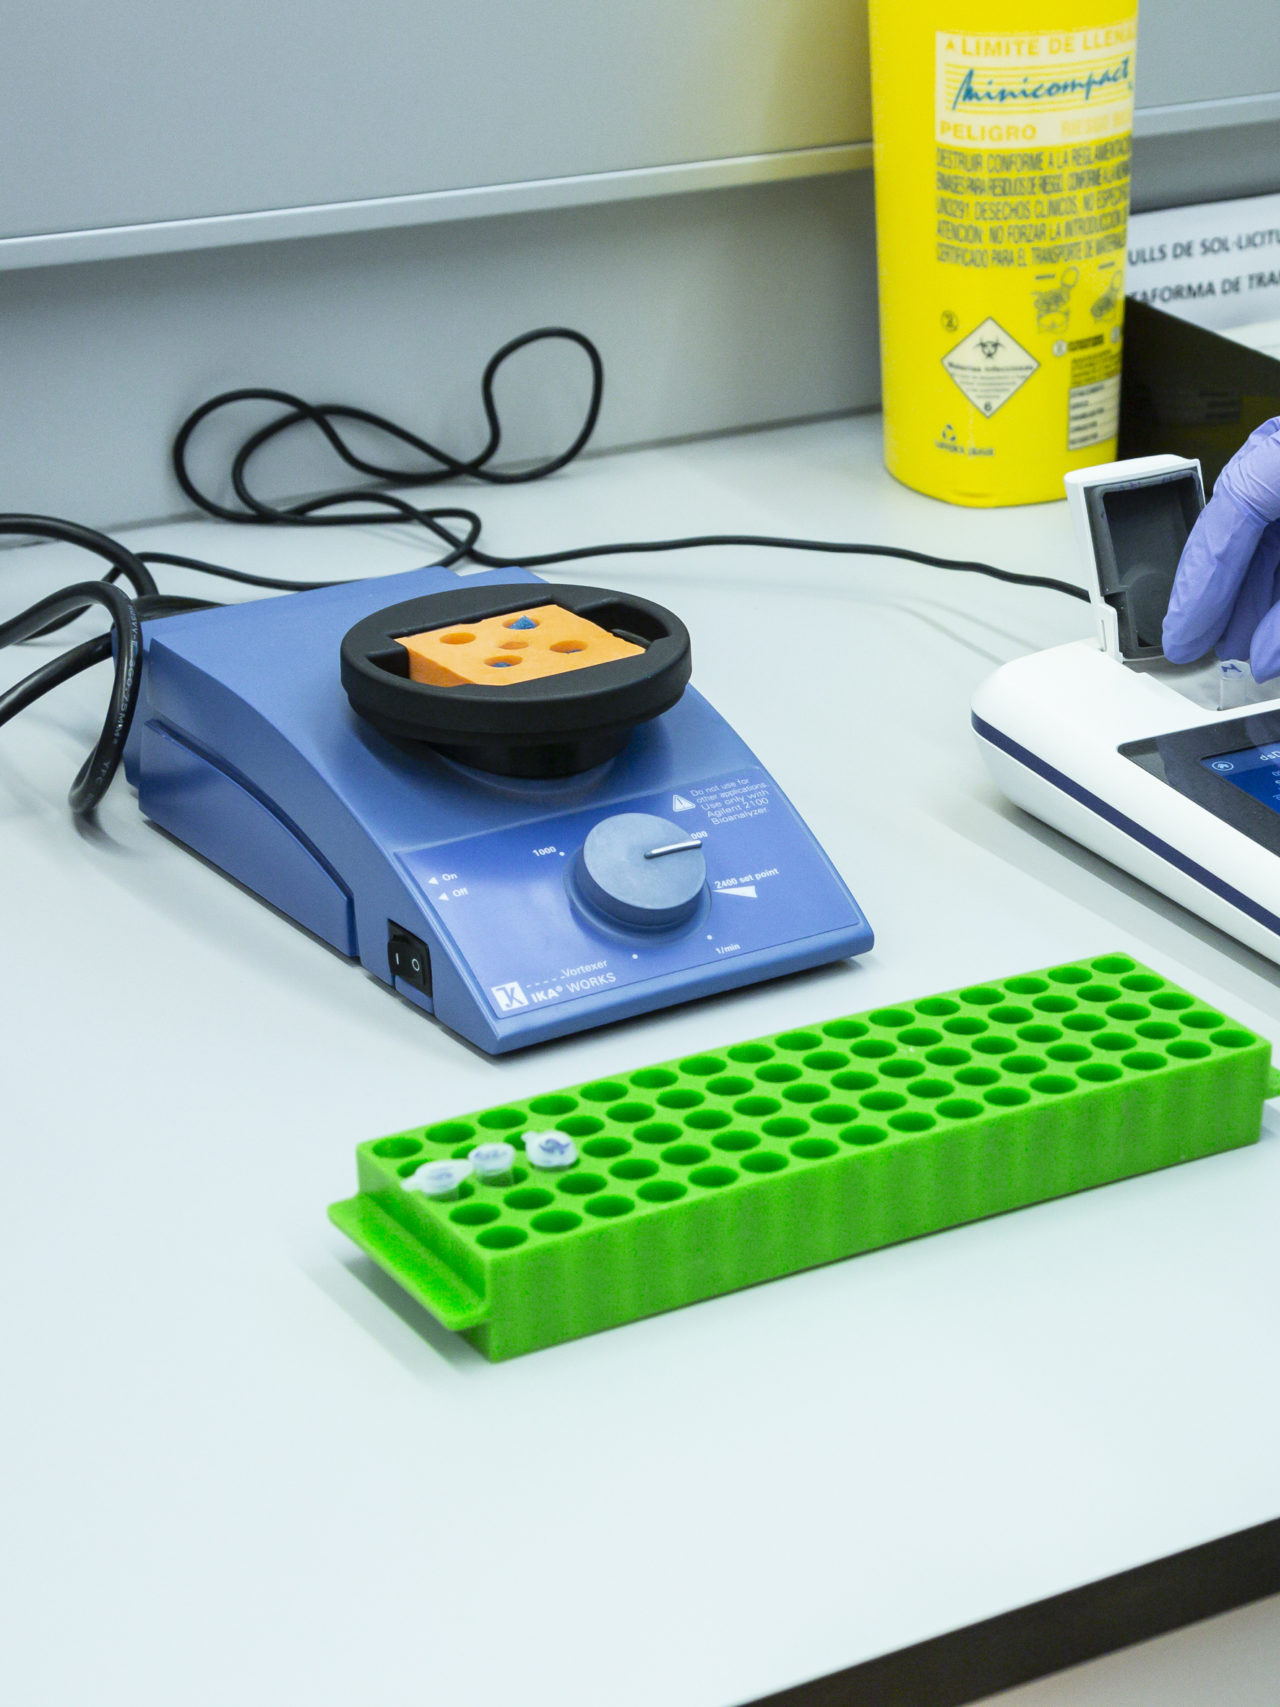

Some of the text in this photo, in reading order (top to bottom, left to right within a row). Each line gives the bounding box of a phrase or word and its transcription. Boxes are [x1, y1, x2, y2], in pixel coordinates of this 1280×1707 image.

[961, 39, 1040, 57] LIMITE
[1049, 36, 1076, 55] DE
[939, 120, 1037, 142] PELIGRO
[986, 152, 1044, 173] CONFORME
[1048, 151, 1054, 168] A
[1057, 150, 1068, 168] LA
[974, 200, 1031, 220] DESECHOS
[989, 224, 1005, 244] NO
[1007, 222, 1047, 244] FORZAR
[1049, 221, 1062, 241] LA
[990, 247, 1015, 267] PARA
[1016, 246, 1028, 267] EL
[1127, 244, 1167, 267] ULLS
[1171, 240, 1194, 260] DE
[1127, 281, 1216, 304] TAFORMA
[1221, 275, 1242, 295] DE
[690, 789, 704, 797] Do
[705, 785, 720, 793] not
[721, 782, 737, 790] use
[696, 794, 718, 804] other
[700, 789, 769, 811] Use only with
[707, 797, 769, 818] Agilent 2100
[691, 830, 709, 841] 000
[532, 846, 557, 857] 1000
[441, 872, 458, 882] On
[714, 867, 779, 889] 2400 set point
[452, 887, 469, 898] Off
[715, 943, 741, 956] 1/min
[561, 959, 608, 978] Vortexer
[566, 972, 617, 994] WORKS
